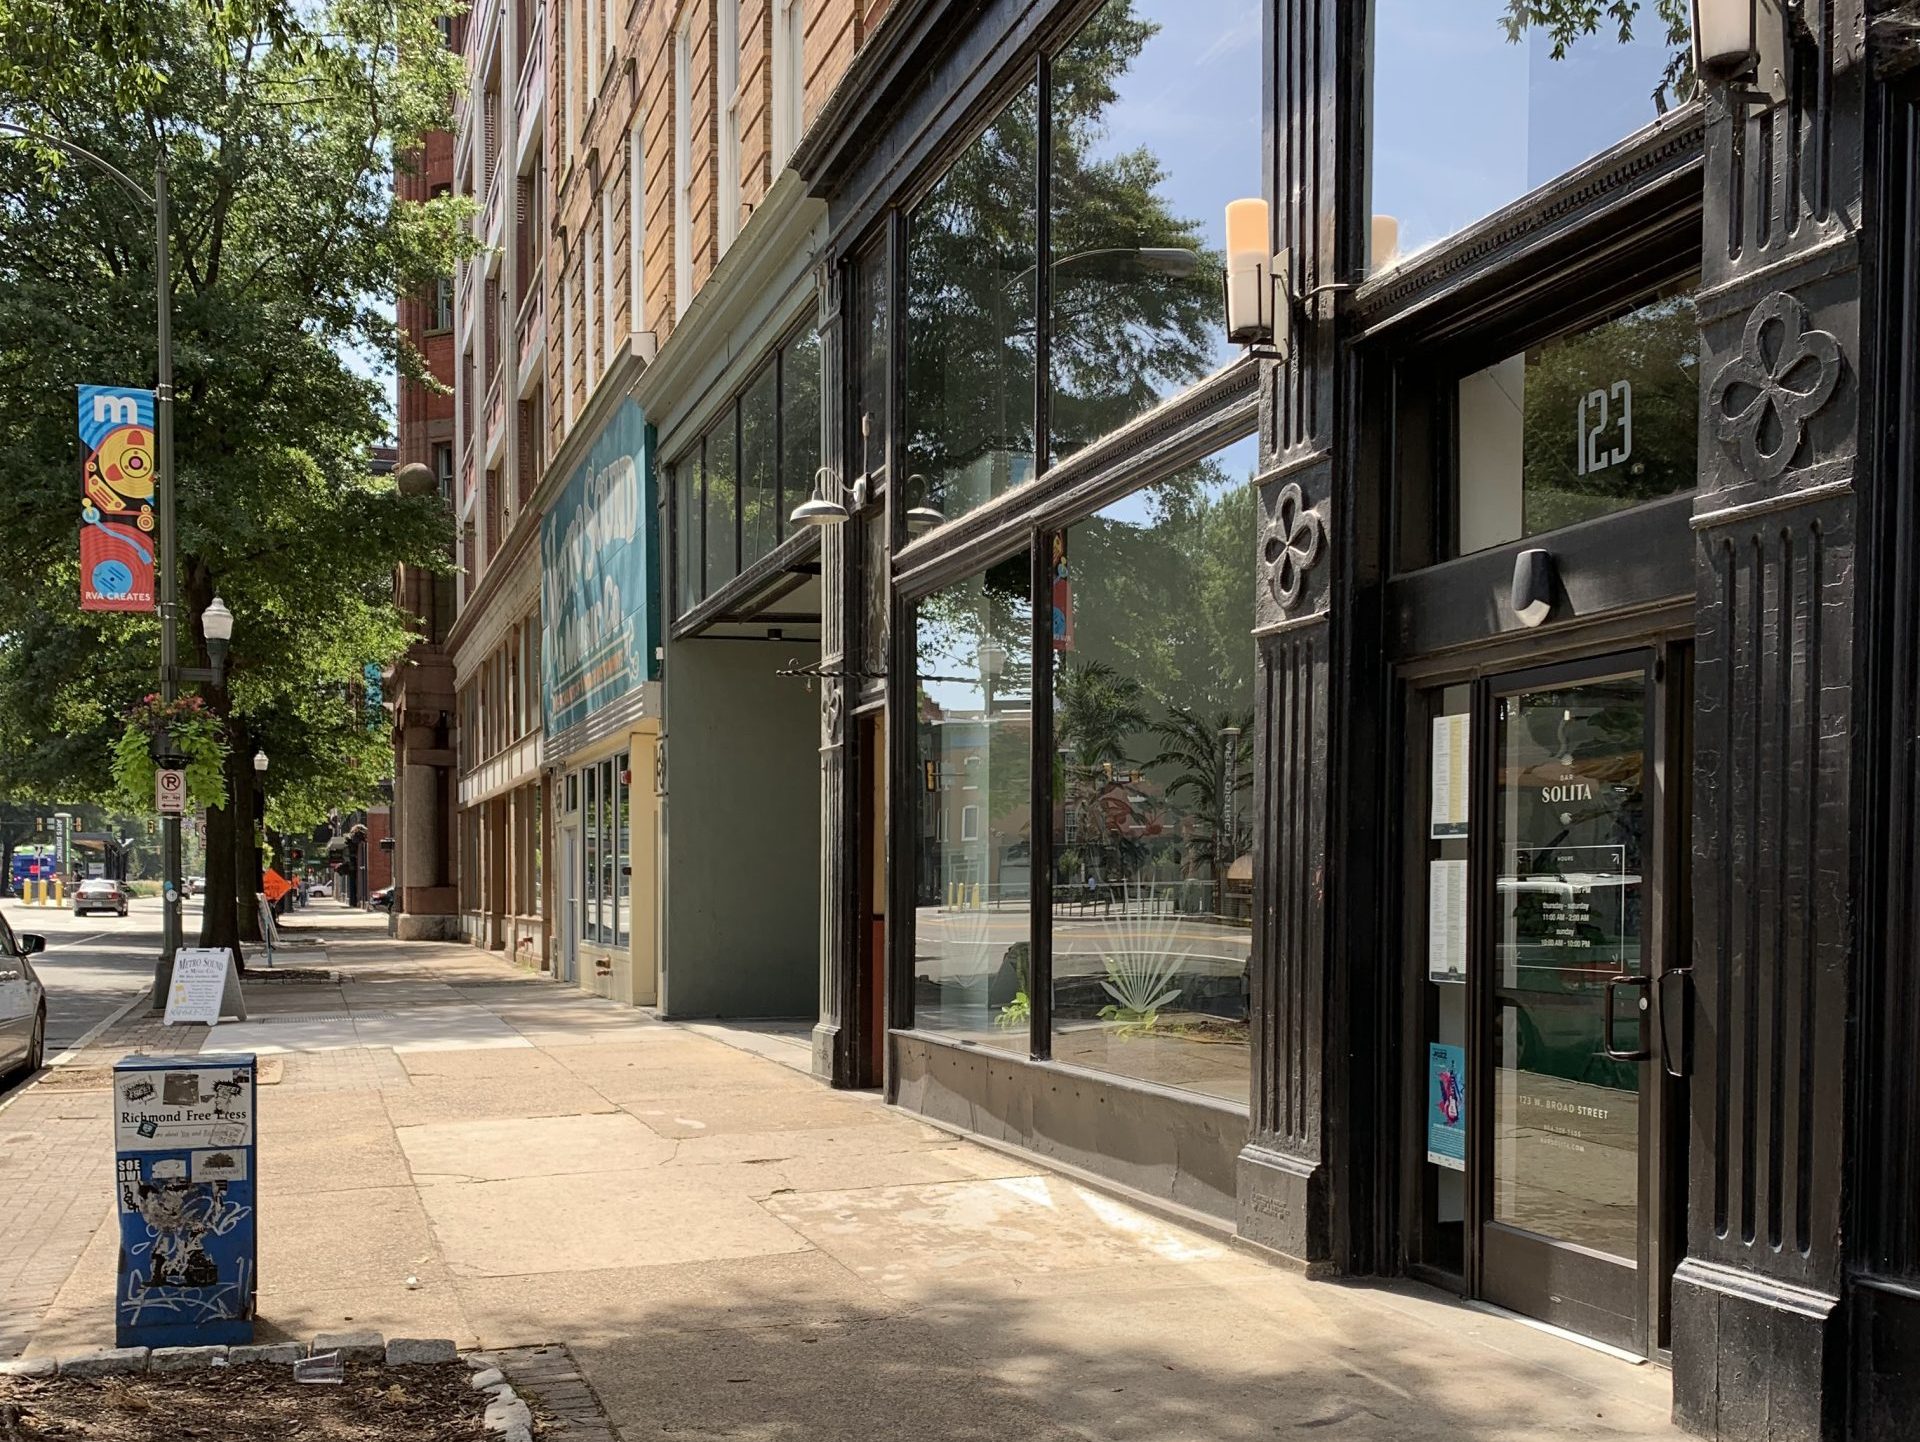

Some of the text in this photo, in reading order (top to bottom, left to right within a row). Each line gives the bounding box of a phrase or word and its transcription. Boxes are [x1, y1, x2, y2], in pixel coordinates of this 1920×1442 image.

[94, 395, 138, 425] m
[1578, 380, 1631, 475] 123
[584, 455, 637, 581] SOUND
[85, 591, 151, 601] RVA CREATES
[1541, 784, 1592, 803] SOLITA
[1557, 913, 1565, 921] AM
[1555, 939, 1563, 947] AM
[1581, 940, 1590, 948] PM
[179, 958, 224, 971] METRO SOUND
[1519, 1095, 1608, 1120] 123 W. BROAD STREET
[122, 1110, 181, 1123] Richmond
[187, 1110, 211, 1120] Free
